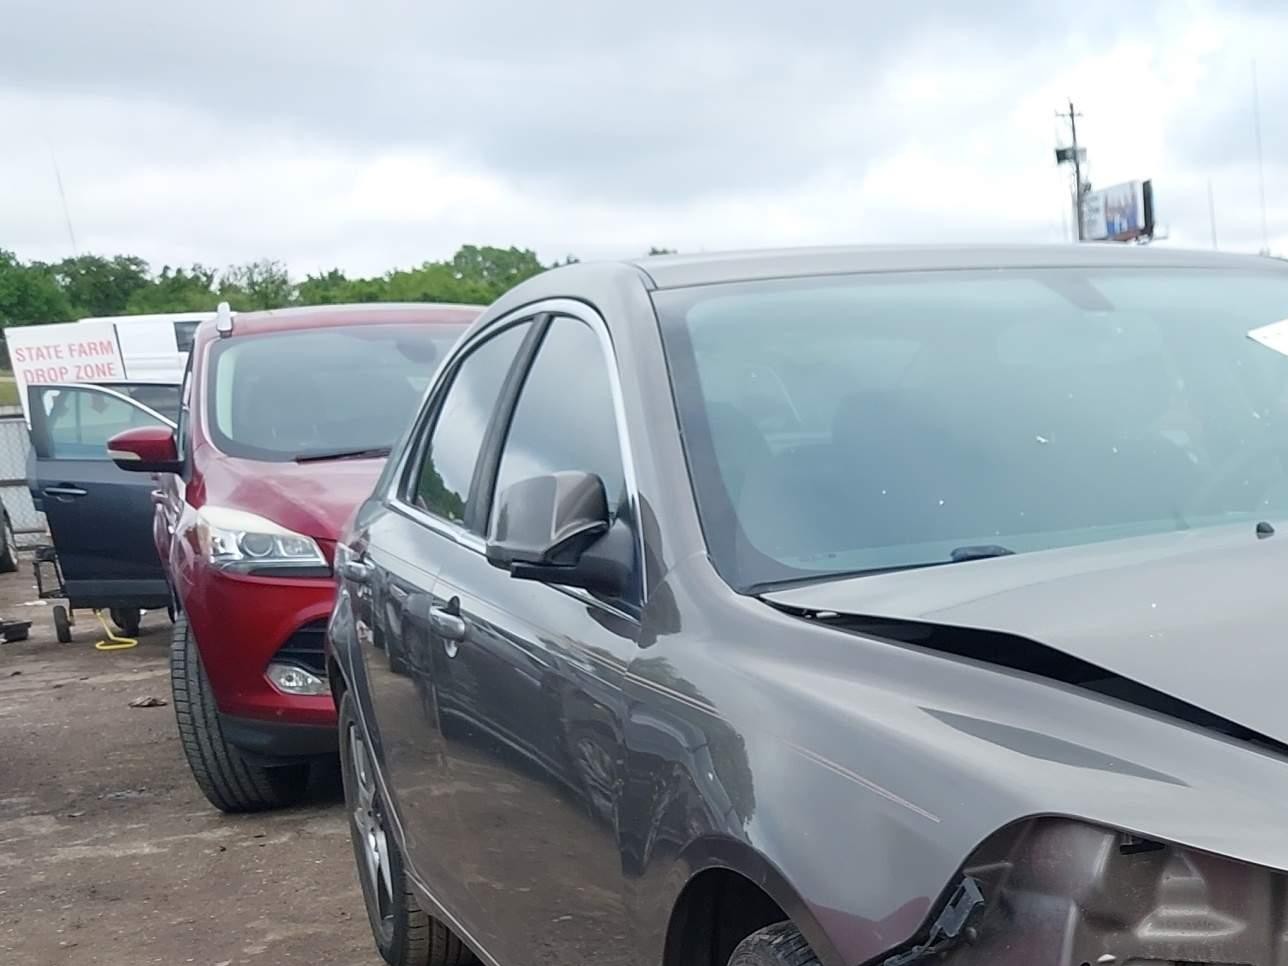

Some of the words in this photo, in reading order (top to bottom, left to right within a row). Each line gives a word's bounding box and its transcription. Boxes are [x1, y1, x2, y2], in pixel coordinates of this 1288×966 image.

[16, 345, 64, 362] STATE
[68, 340, 114, 358] FARM
[23, 366, 69, 383] DROP
[74, 362, 115, 380] ZONE
